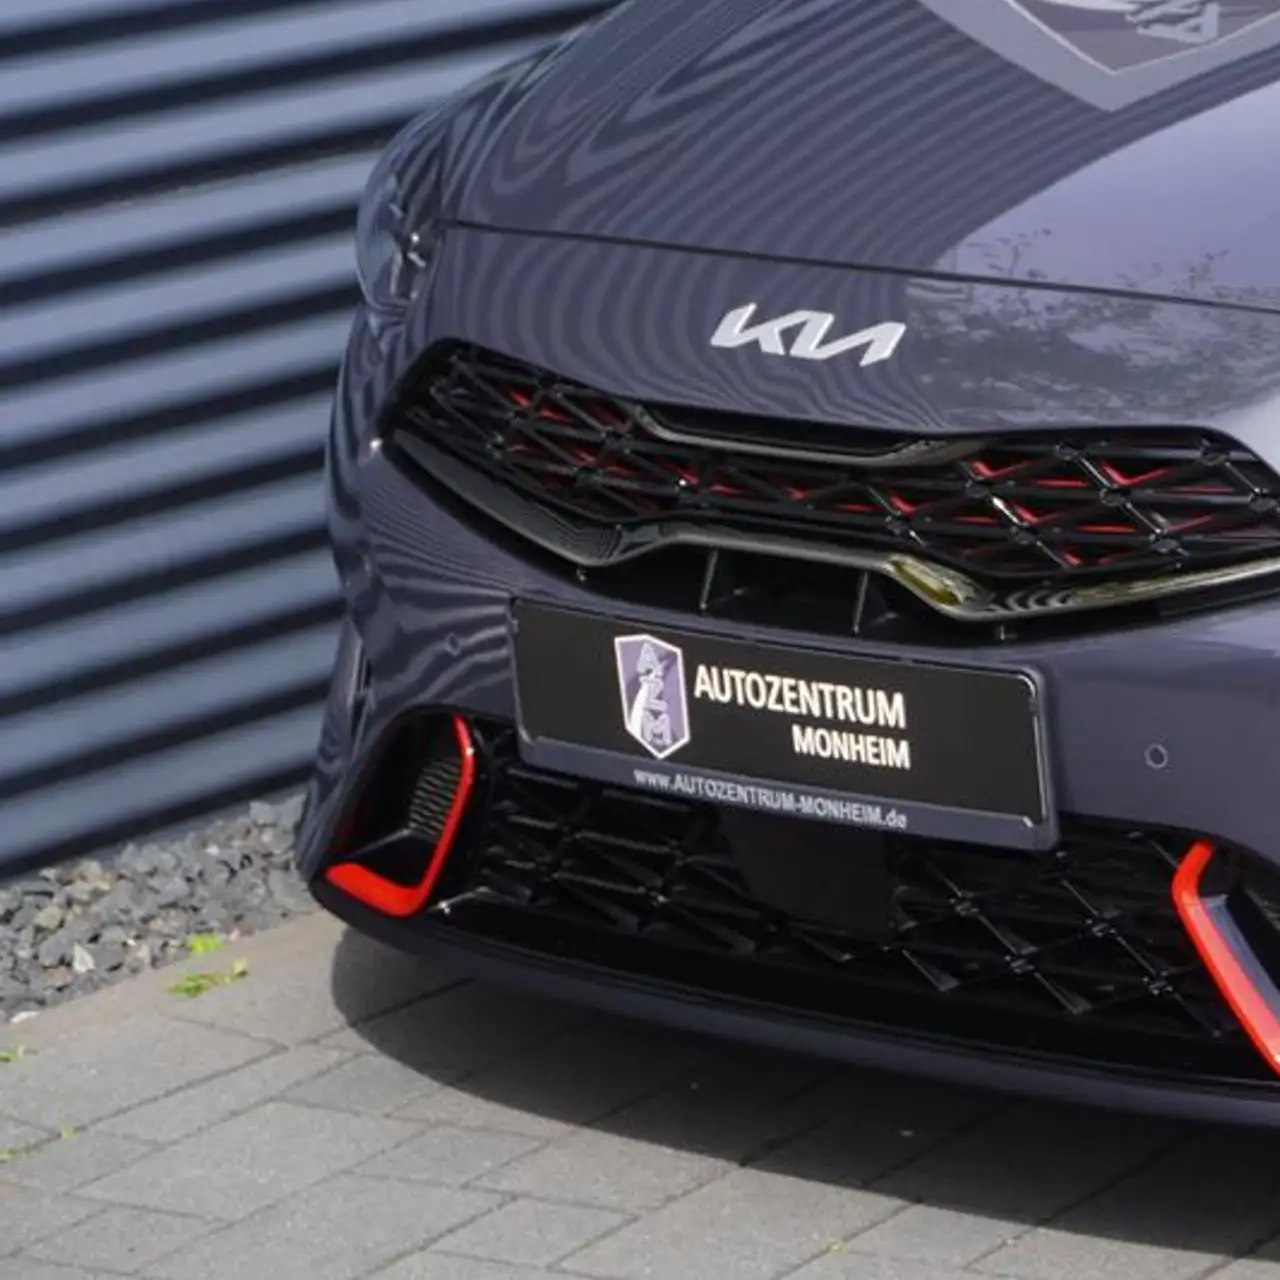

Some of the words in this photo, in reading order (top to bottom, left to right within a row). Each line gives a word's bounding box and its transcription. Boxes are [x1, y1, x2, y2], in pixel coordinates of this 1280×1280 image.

[710, 302, 907, 367] KIA
[693, 663, 907, 729] AUTOZENTRUM
[792, 724, 911, 770] MONHEIM
[633, 768, 907, 829] www.AUTOZENTRUM-MONHEIM.de
